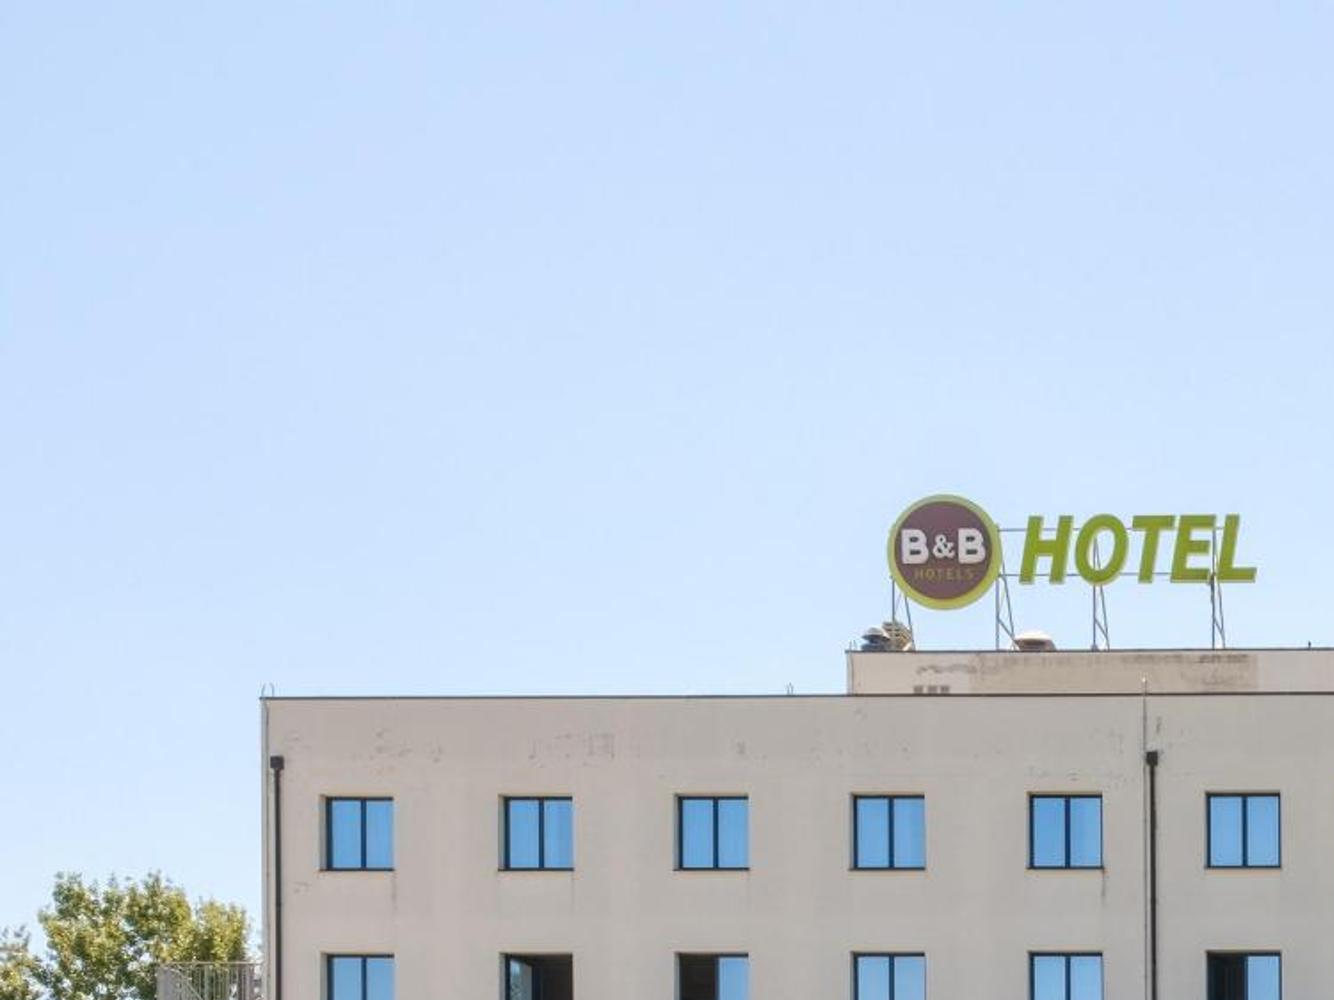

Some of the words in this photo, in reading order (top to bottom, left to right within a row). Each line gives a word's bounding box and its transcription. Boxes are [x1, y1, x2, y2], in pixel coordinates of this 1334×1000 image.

[902, 528, 986, 564] B&B
[1018, 514, 1257, 584] HOTEL
[914, 567, 974, 580] HOTELS
